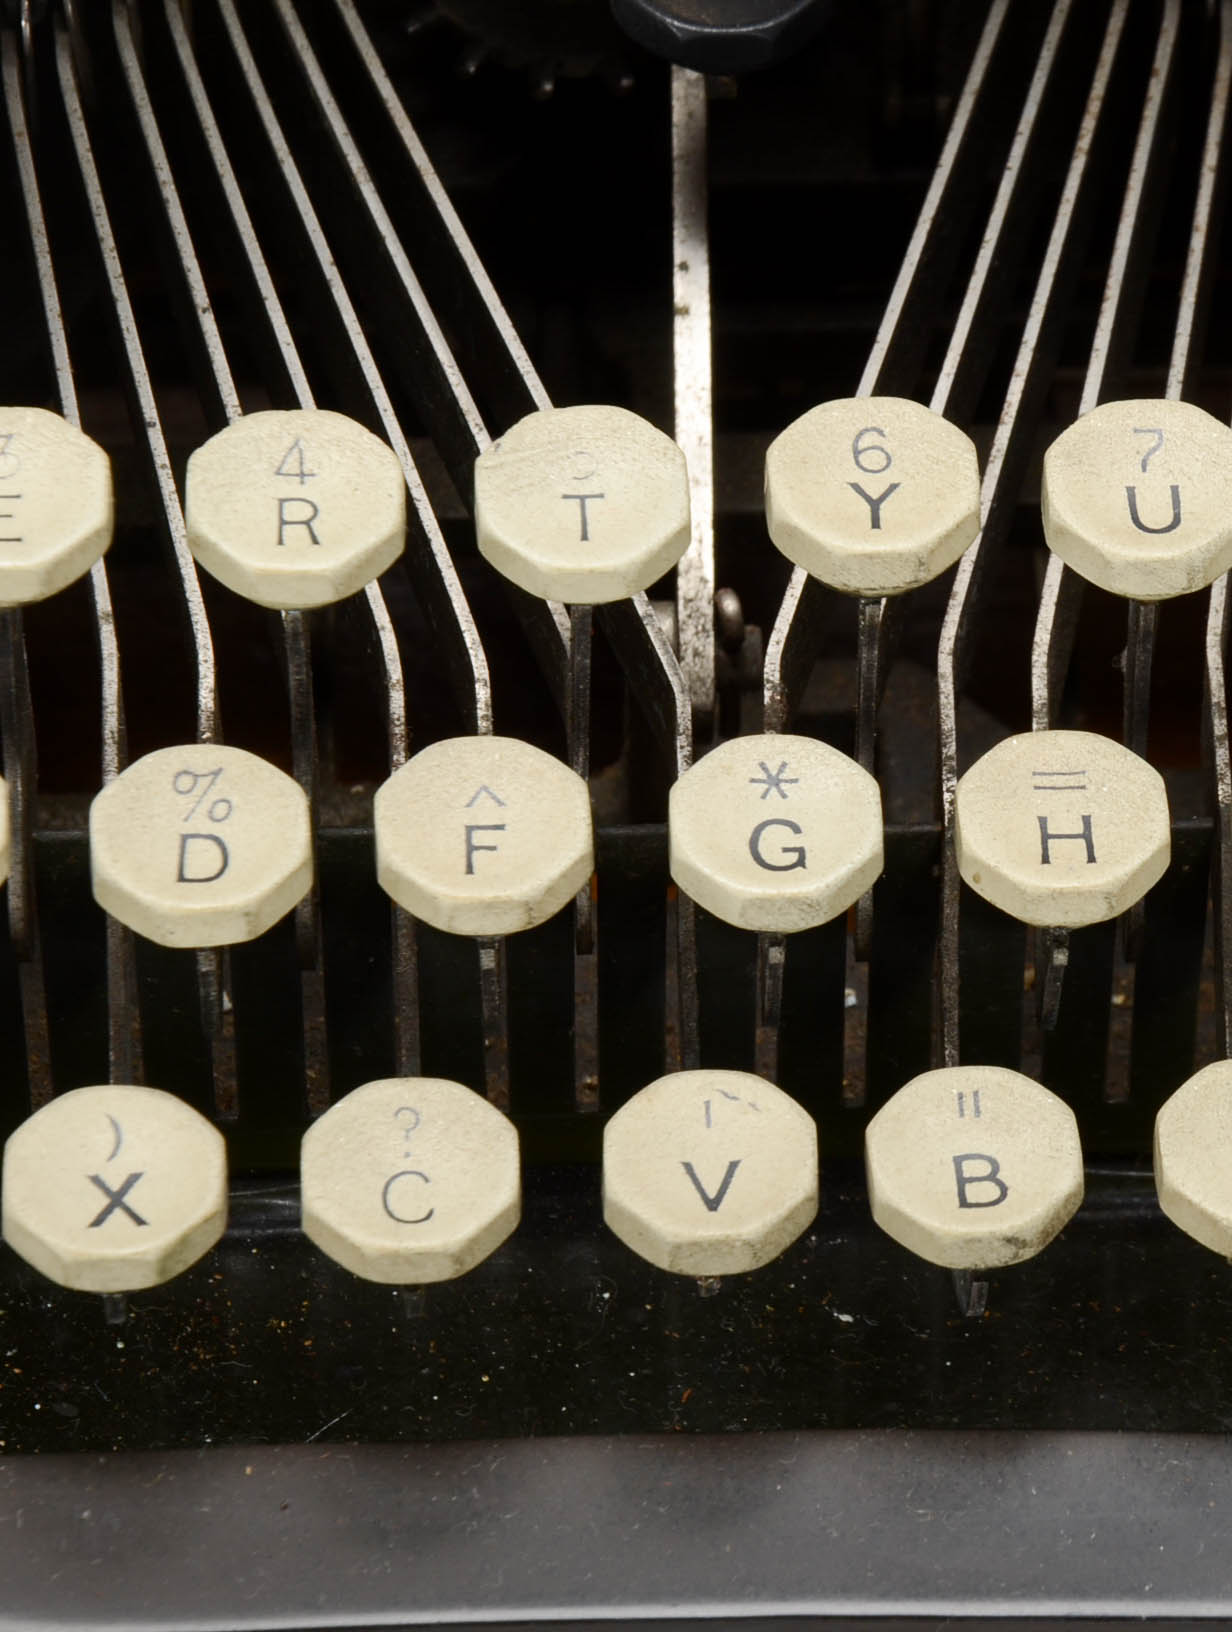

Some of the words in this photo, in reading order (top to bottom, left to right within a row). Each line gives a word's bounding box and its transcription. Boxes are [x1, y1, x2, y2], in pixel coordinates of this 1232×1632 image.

[274, 438, 316, 485] 4
[852, 427, 892, 474] 6
[1133, 428, 1163, 473] 7
[277, 498, 320, 546] R
[562, 493, 604, 541] T
[849, 483, 900, 529] Y
[1126, 486, 1181, 534] U
[172, 767, 232, 823] %
[1032, 771, 1087, 790] =
[177, 834, 229, 883] D
[465, 824, 505, 875] F
[749, 819, 806, 871] G
[1038, 815, 1096, 864] H
[394, 1106, 421, 1159] ?
[88, 1173, 148, 1228] X
[382, 1171, 434, 1224] C
[682, 1160, 740, 1212] V
[953, 1154, 1008, 1209] B
